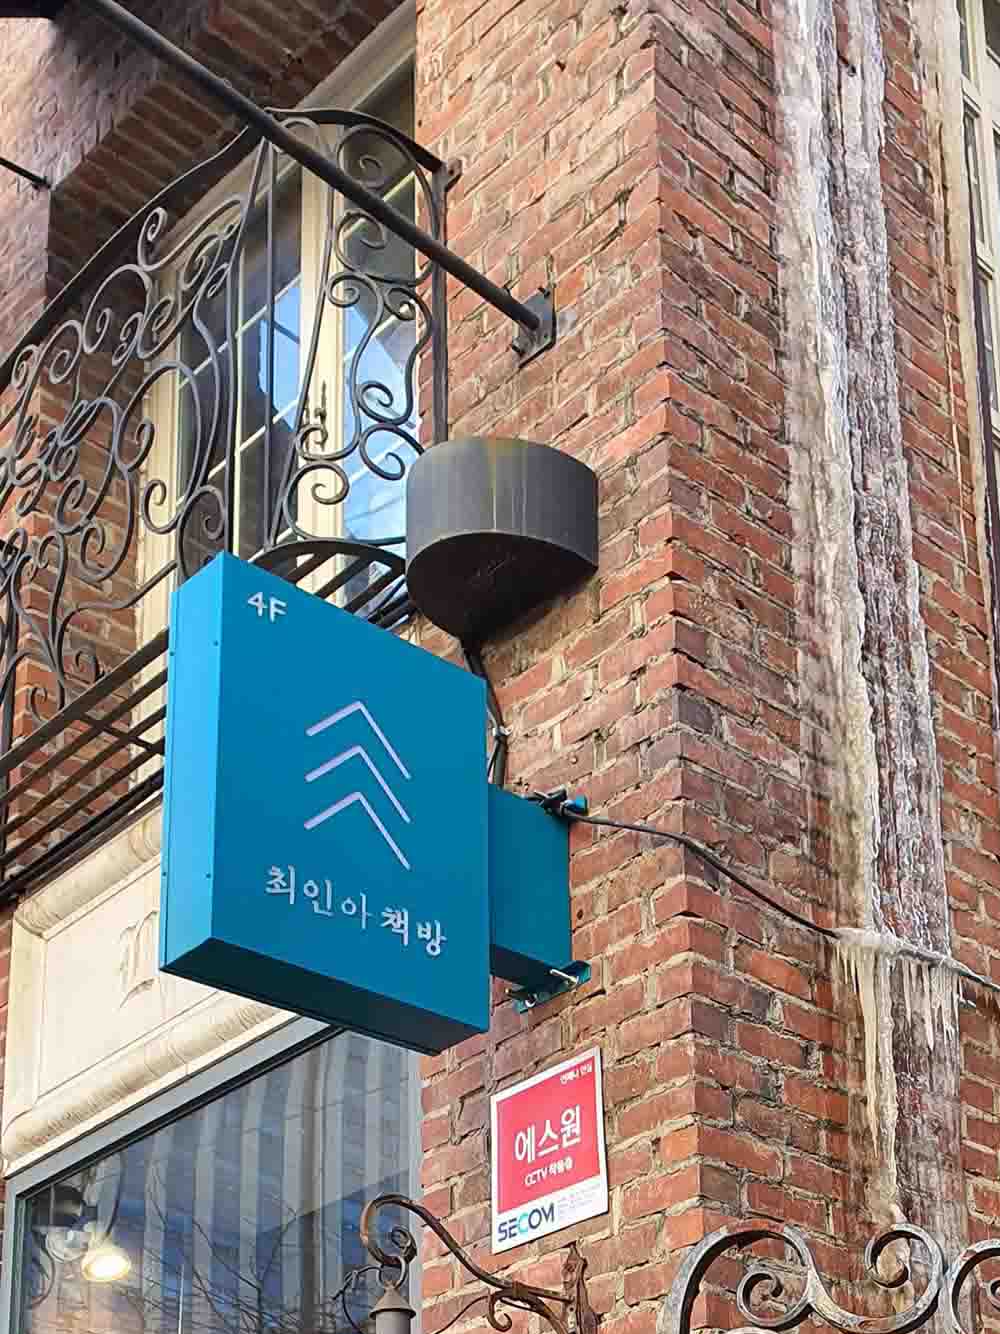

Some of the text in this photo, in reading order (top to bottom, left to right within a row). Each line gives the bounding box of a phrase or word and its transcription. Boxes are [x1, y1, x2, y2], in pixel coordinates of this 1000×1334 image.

[248, 591, 288, 622] 4F
[514, 1104, 581, 1164] 에스원
[525, 1166, 548, 1187] CCTV
[498, 1202, 555, 1243] SECOM
